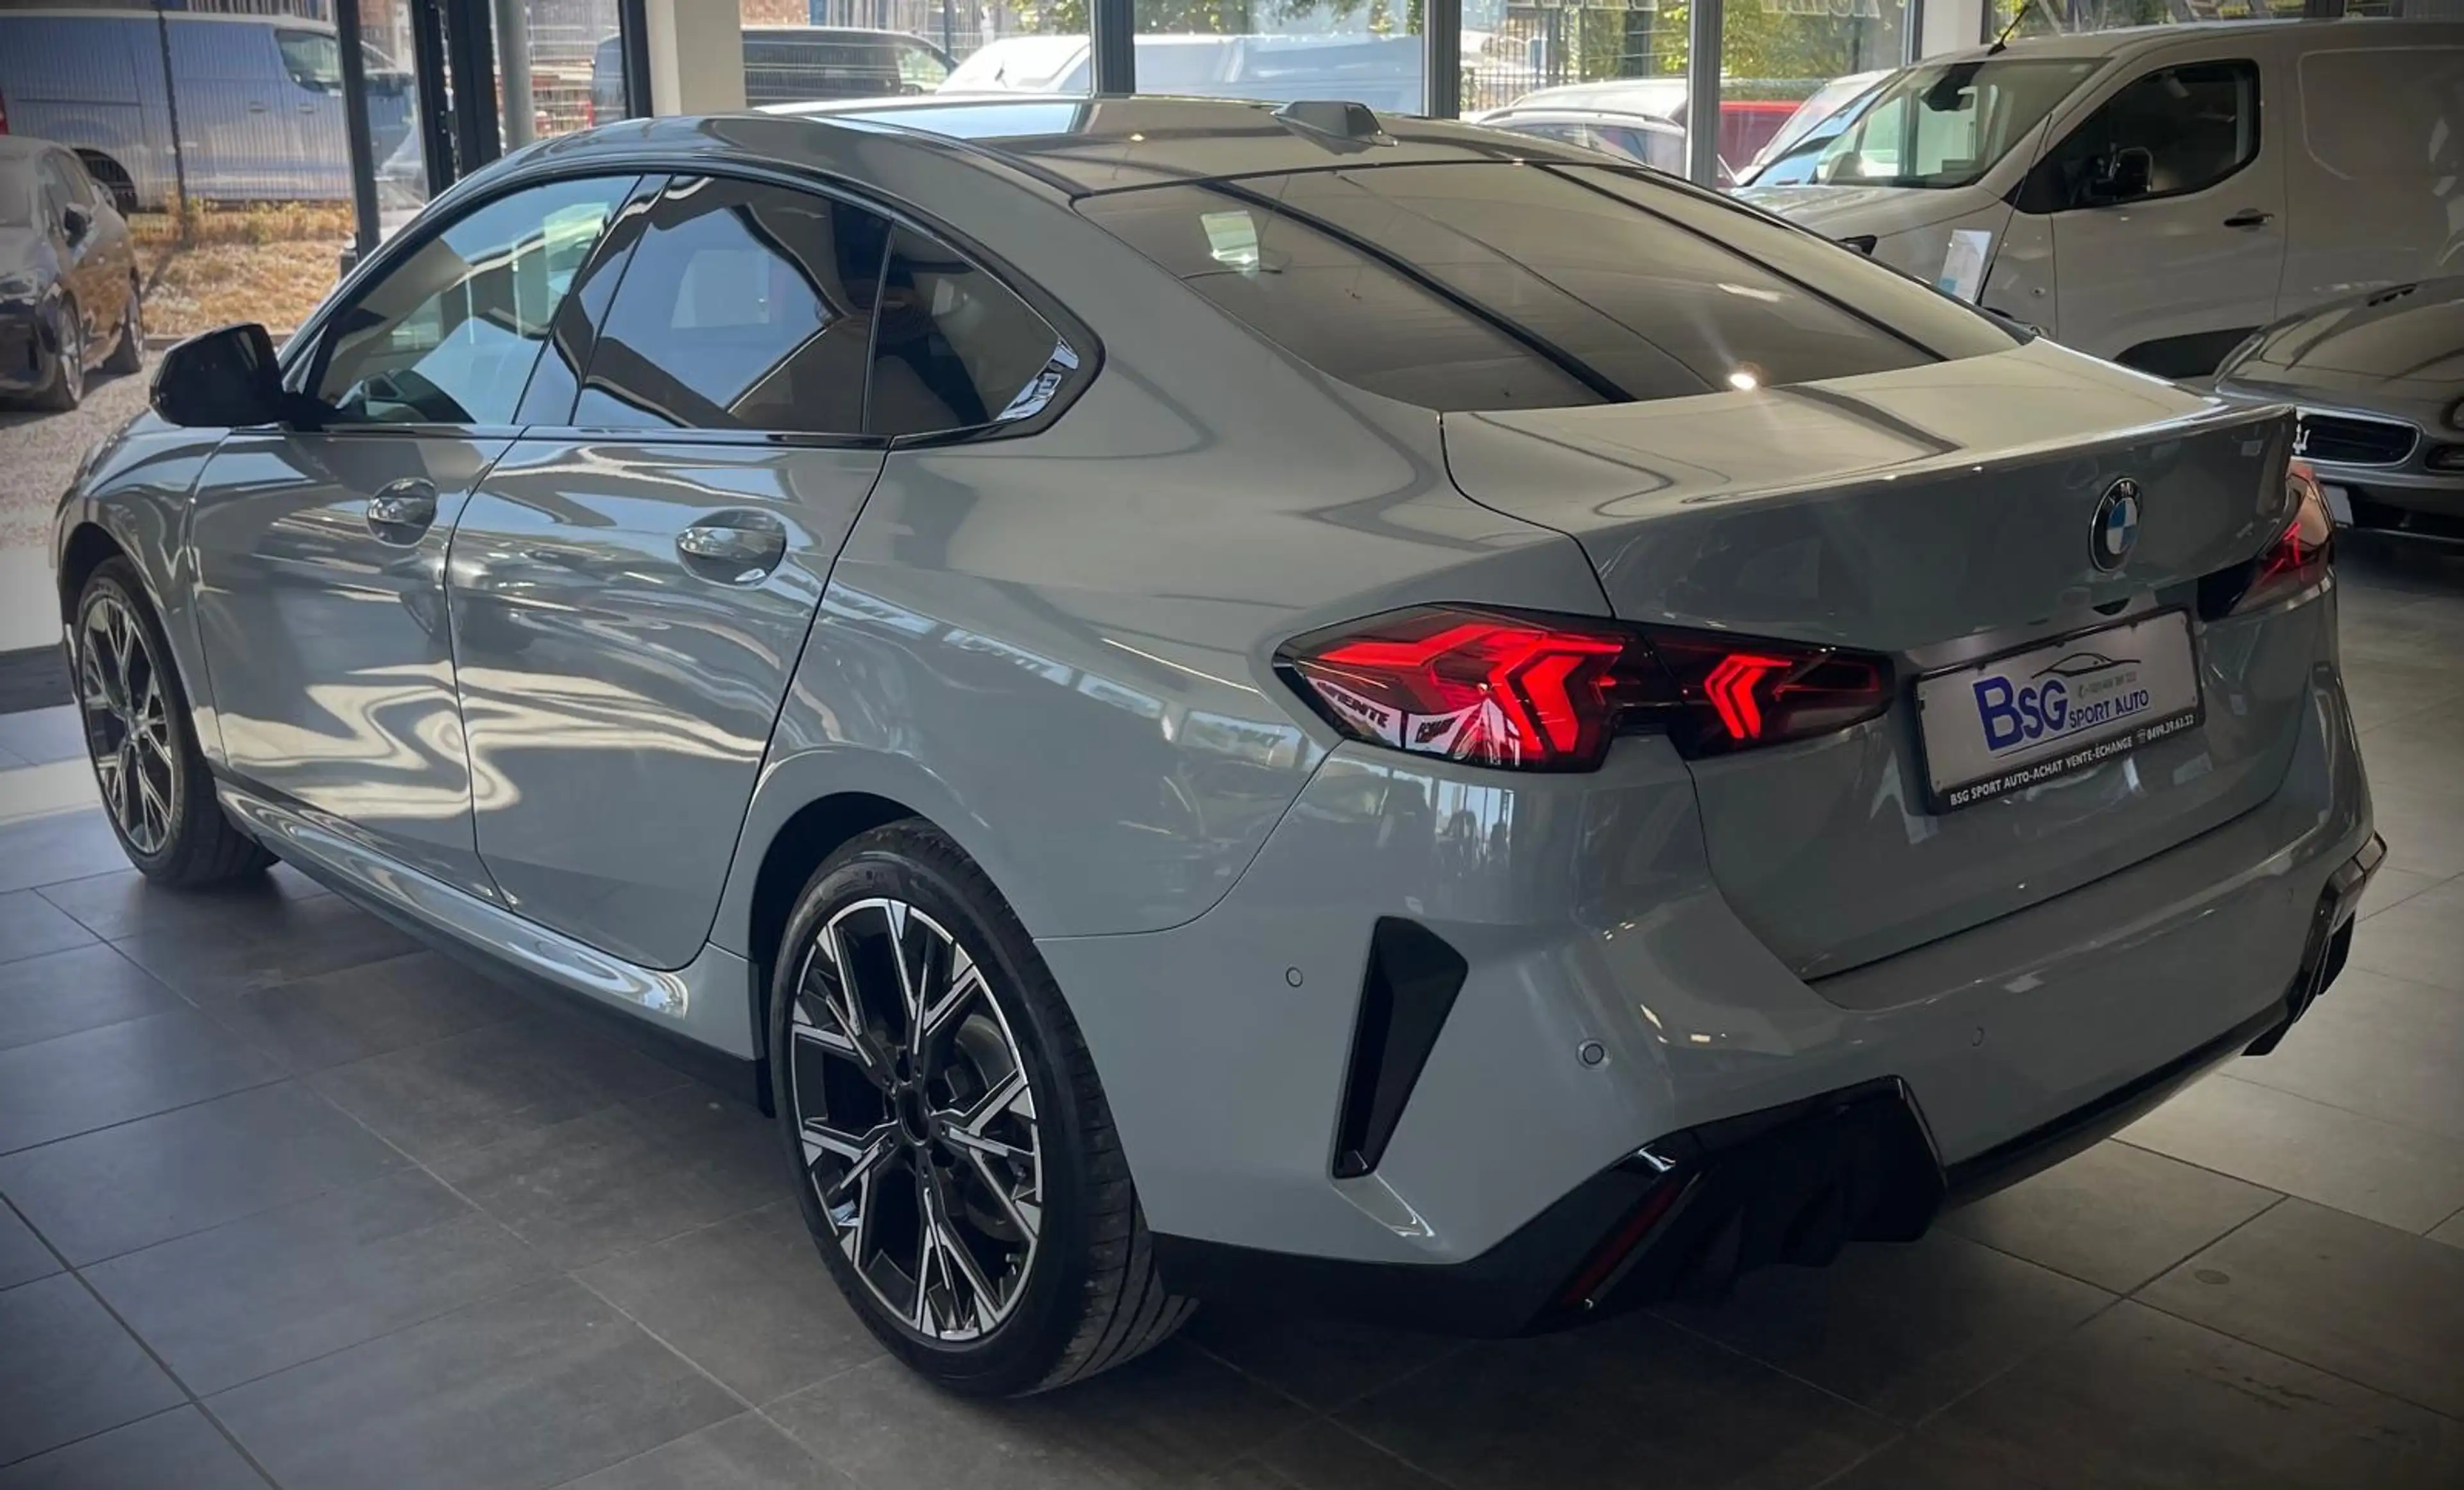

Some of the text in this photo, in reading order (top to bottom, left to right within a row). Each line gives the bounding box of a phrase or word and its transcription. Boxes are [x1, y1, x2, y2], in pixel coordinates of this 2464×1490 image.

[2069, 700, 2110, 729] SPORT
[2115, 689, 2150, 715] AUTO
[1950, 788, 1969, 805] BSG
[1971, 778, 2001, 800] SPORT
[2003, 759, 2063, 789] AUTO-ACHAT
